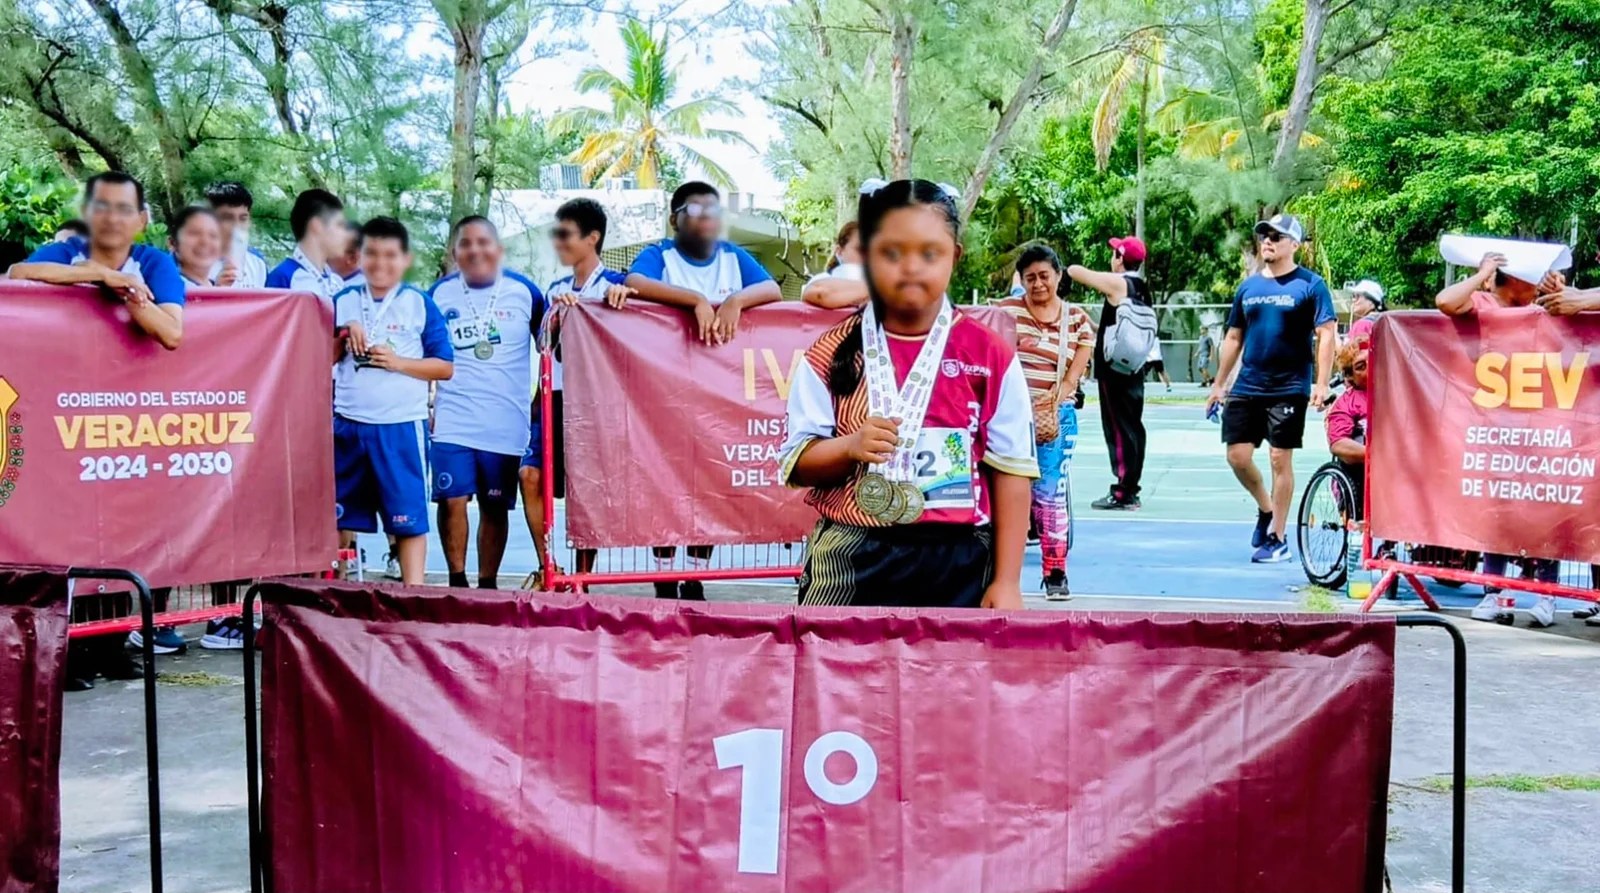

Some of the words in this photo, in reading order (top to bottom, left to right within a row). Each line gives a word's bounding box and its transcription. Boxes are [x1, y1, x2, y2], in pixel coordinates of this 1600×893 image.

[1472, 351, 1590, 410] SEV
[57, 392, 137, 408] GOBIERNO
[140, 392, 168, 407] DEL
[171, 391, 226, 406] ESTADO
[228, 391, 246, 405] DE
[54, 411, 255, 449] VERACRUZ
[1465, 425, 1573, 448] SECRETARÍA
[722, 444, 780, 461] VERA
[1463, 452, 1487, 471] DE
[1491, 452, 1595, 477] EDUCACIÓN
[79, 454, 148, 481] 2024
[168, 451, 233, 477] 2030
[731, 469, 771, 486] DEL
[1461, 478, 1485, 497] DE
[1488, 481, 1584, 505] VERACRUZ
